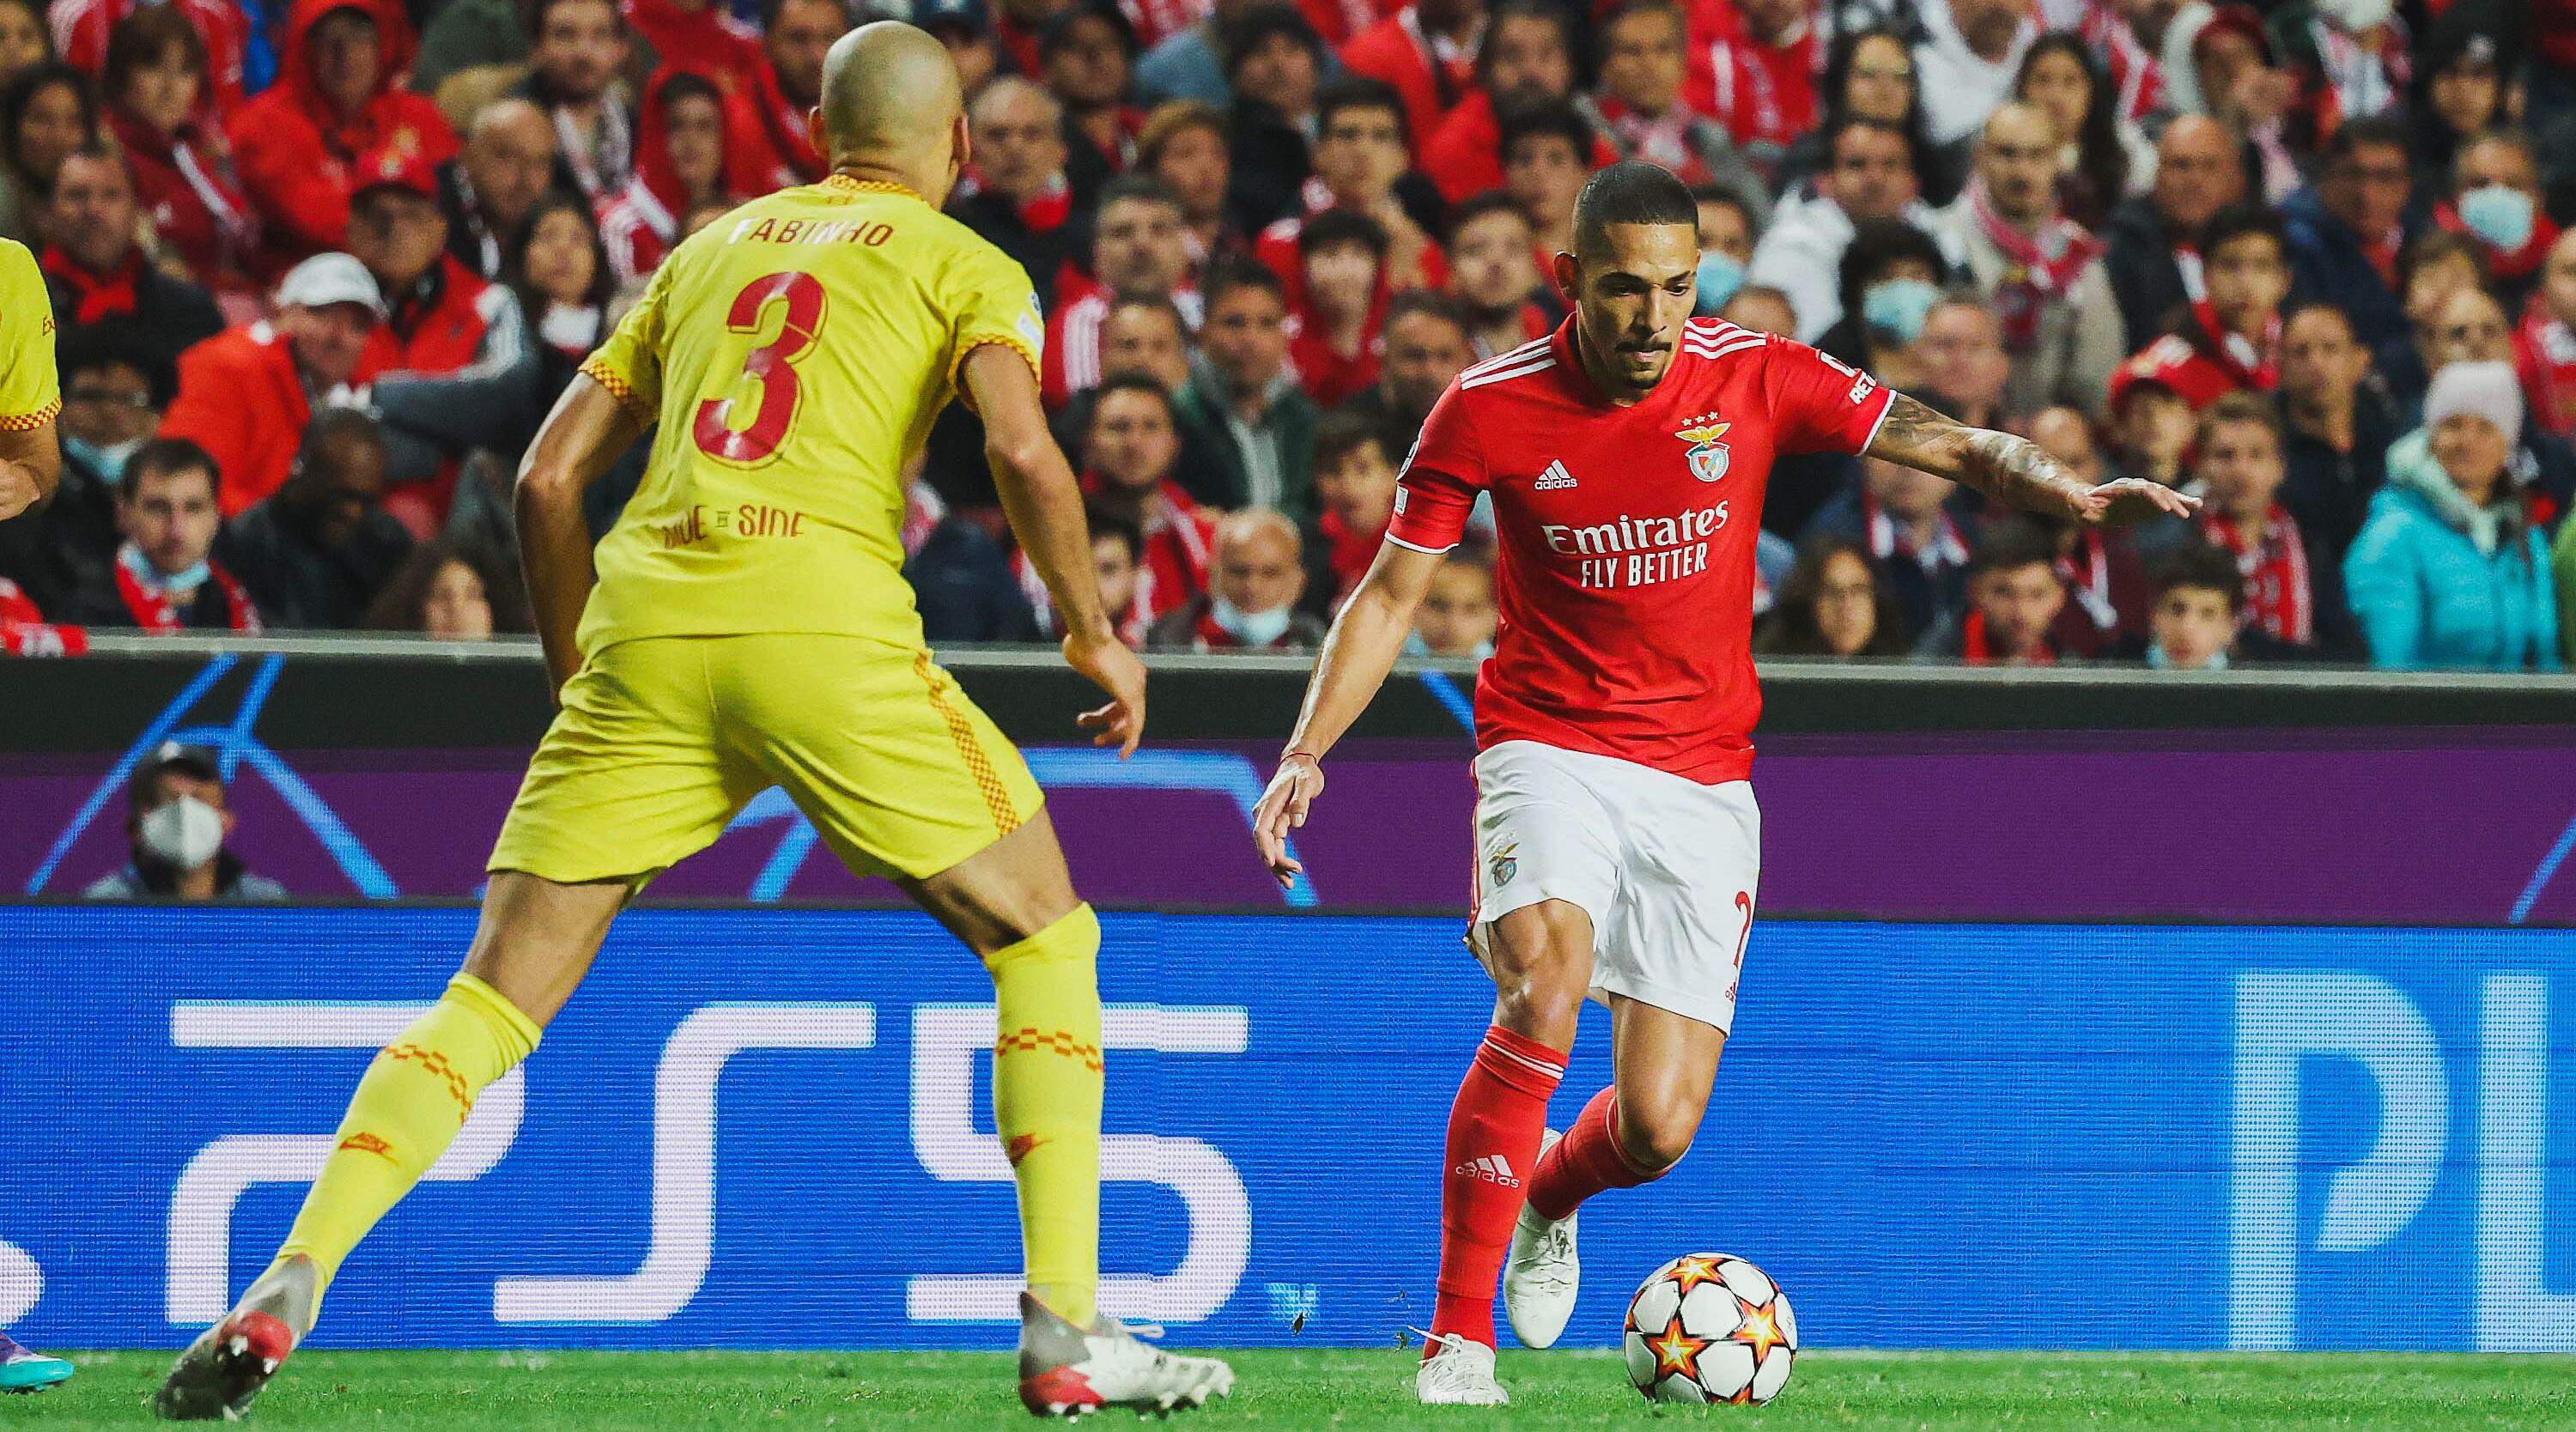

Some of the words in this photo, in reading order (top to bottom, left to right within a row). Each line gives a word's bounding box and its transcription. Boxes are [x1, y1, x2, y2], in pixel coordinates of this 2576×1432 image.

[728, 216, 894, 247] FABINHO
[693, 271, 828, 470] 3
[1534, 477, 1578, 490] adidas
[1542, 499, 1728, 555] Emirates
[1582, 558, 1619, 588] FLY
[1627, 542, 1708, 586] BETTER
[1455, 1166, 1520, 1188] adidas
[2229, 968, 2576, 1353] PL
